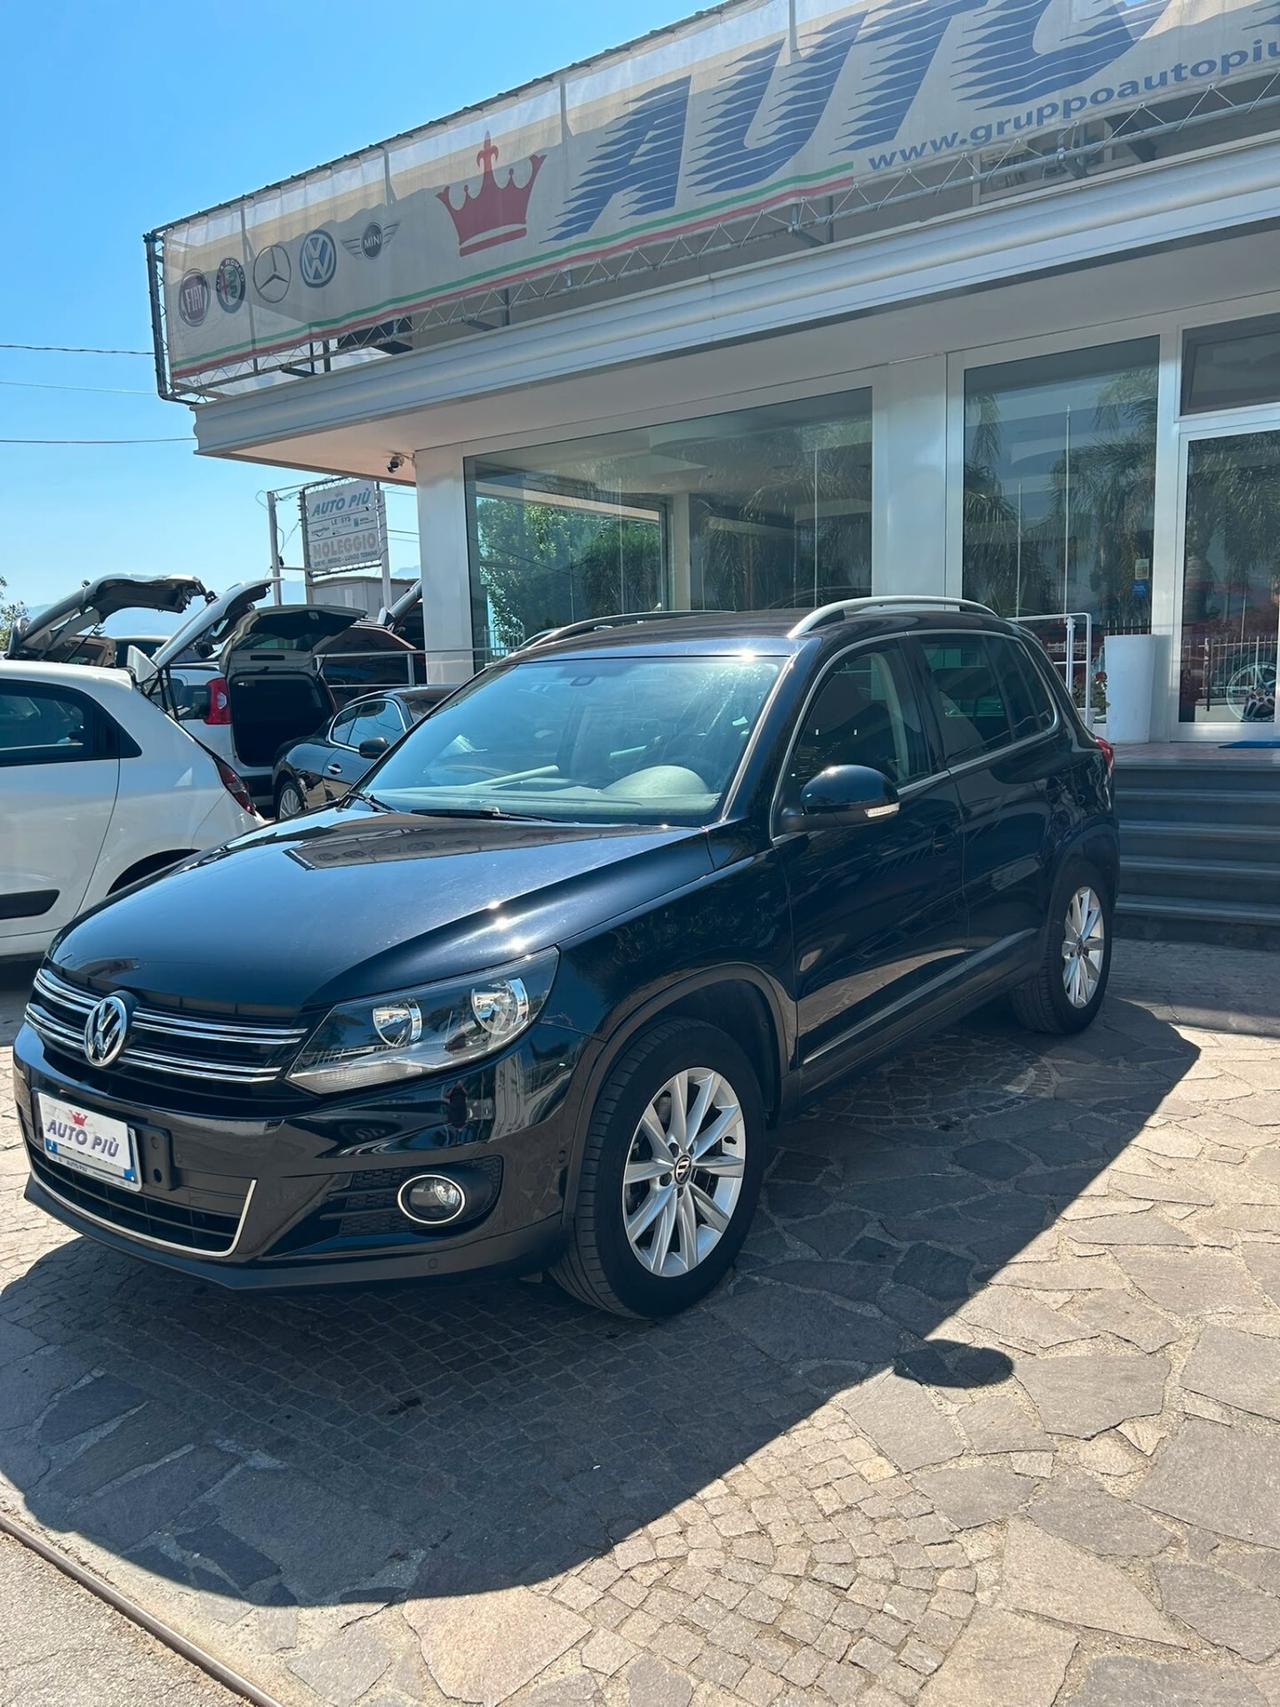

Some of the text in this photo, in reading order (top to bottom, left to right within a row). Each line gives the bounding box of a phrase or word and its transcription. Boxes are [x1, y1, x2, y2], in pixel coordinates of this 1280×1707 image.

[364, 231, 382, 247] MINI
[185, 284, 204, 313] FIAT
[312, 498, 345, 516] AUTO
[312, 532, 376, 560] NOLEGGIO
[48, 1120, 119, 1157] AUTO PIÙ
